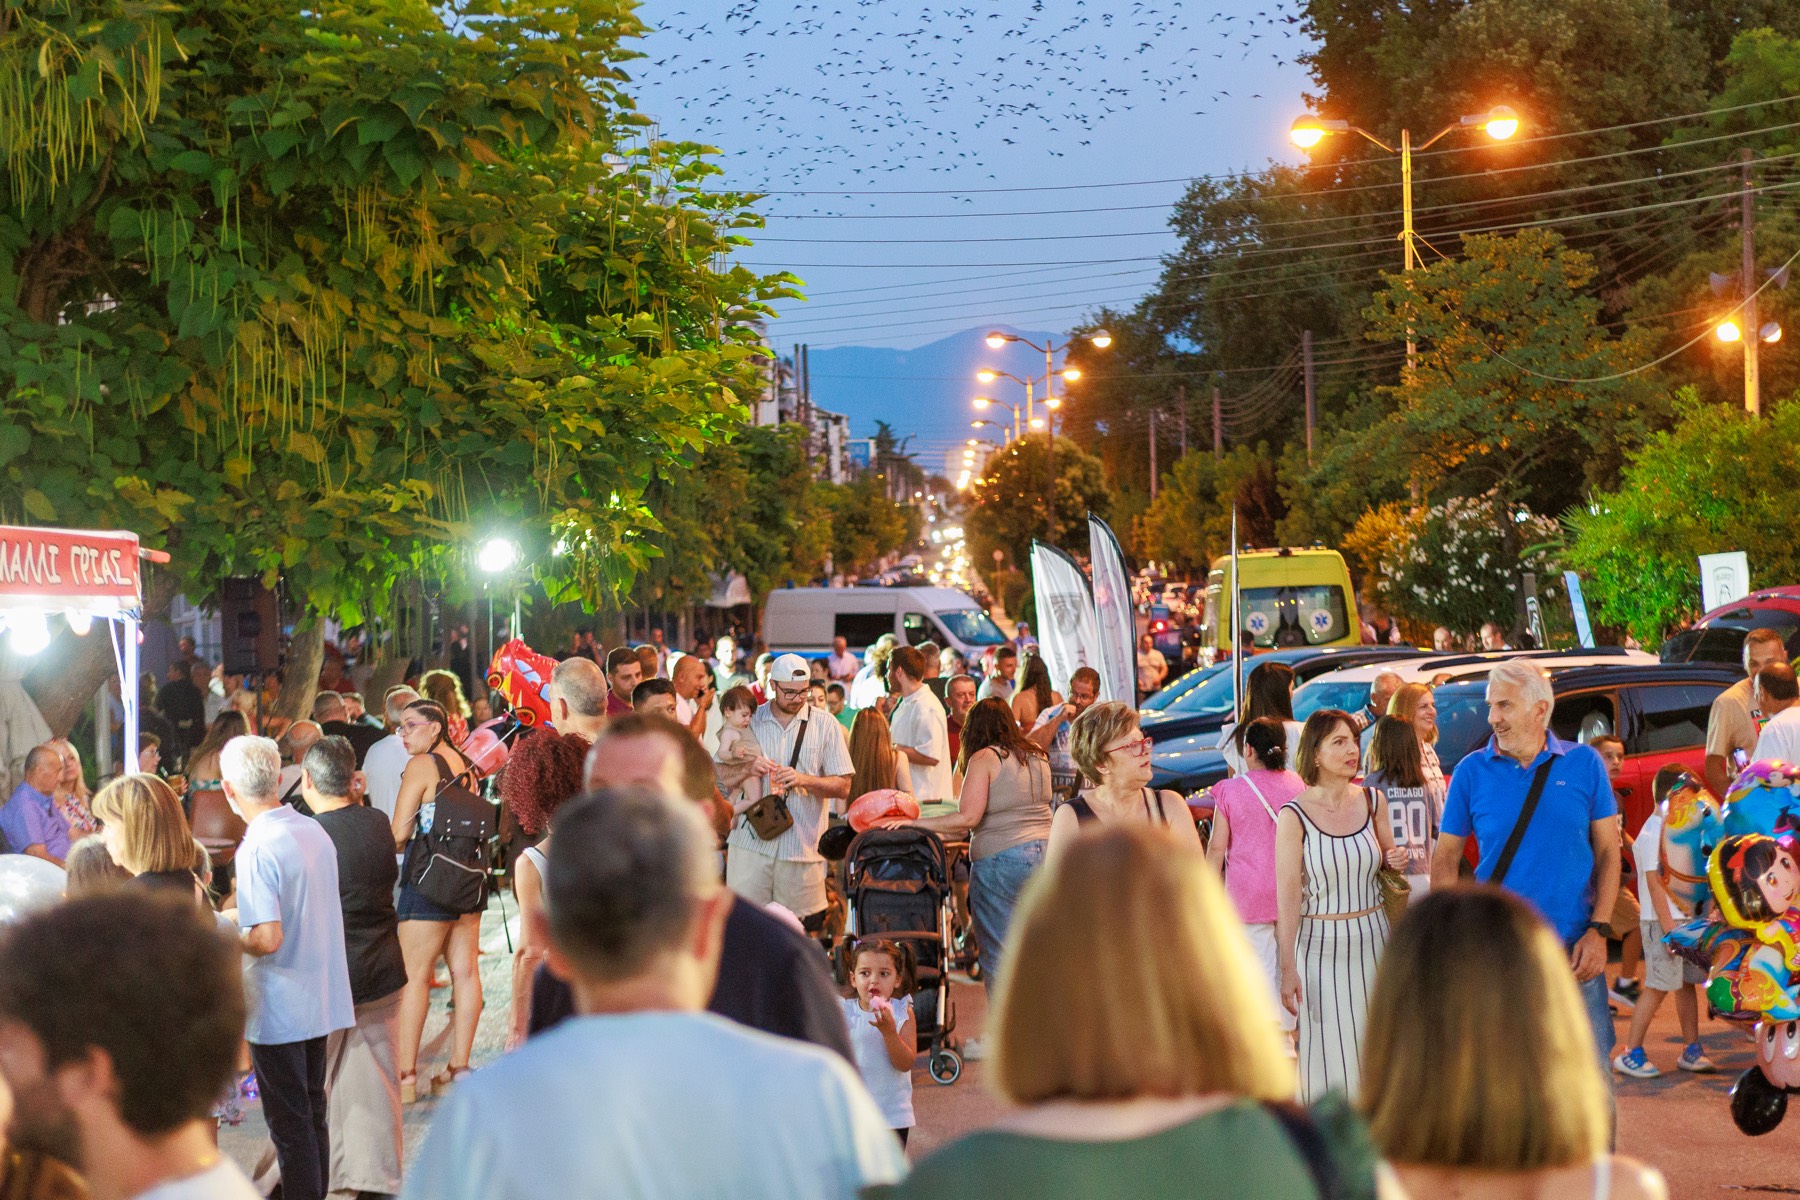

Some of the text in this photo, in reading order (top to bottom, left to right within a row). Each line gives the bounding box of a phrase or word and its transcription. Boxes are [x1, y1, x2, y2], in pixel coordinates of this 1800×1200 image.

[70, 544, 132, 585] ΓΡΙΑΣ
[1387, 786, 1424, 799] CHICAGO
[1388, 801, 1426, 846] 80
